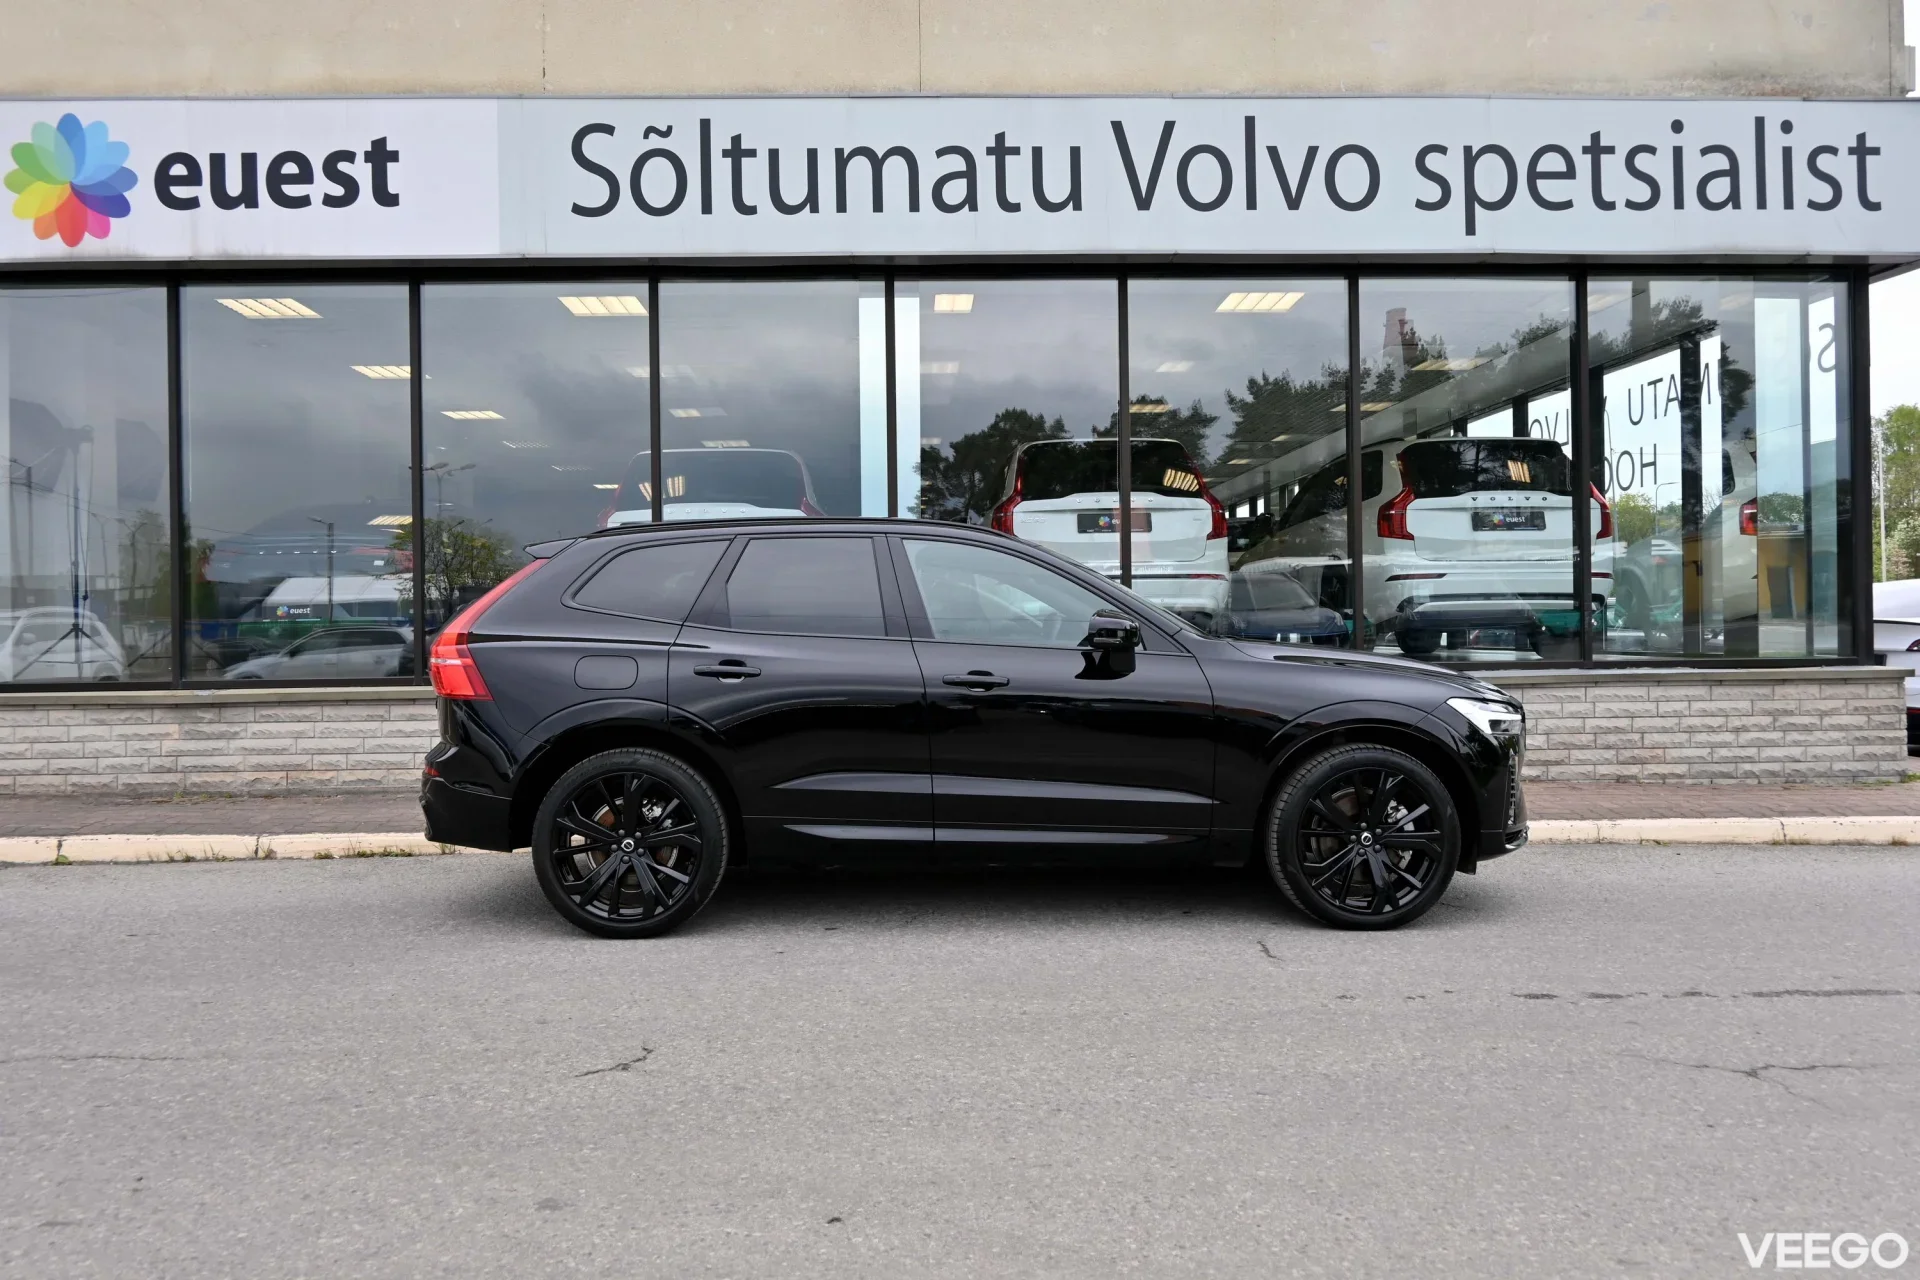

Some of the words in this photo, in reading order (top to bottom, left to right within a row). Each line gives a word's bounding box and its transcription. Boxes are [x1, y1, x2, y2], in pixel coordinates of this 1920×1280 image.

[153, 136, 400, 210] euest
[570, 118, 1083, 218] Sõltumatu
[1109, 115, 1381, 213] Volvo
[1414, 116, 1882, 237] spetsialist
[1505, 515, 1526, 523] euest
